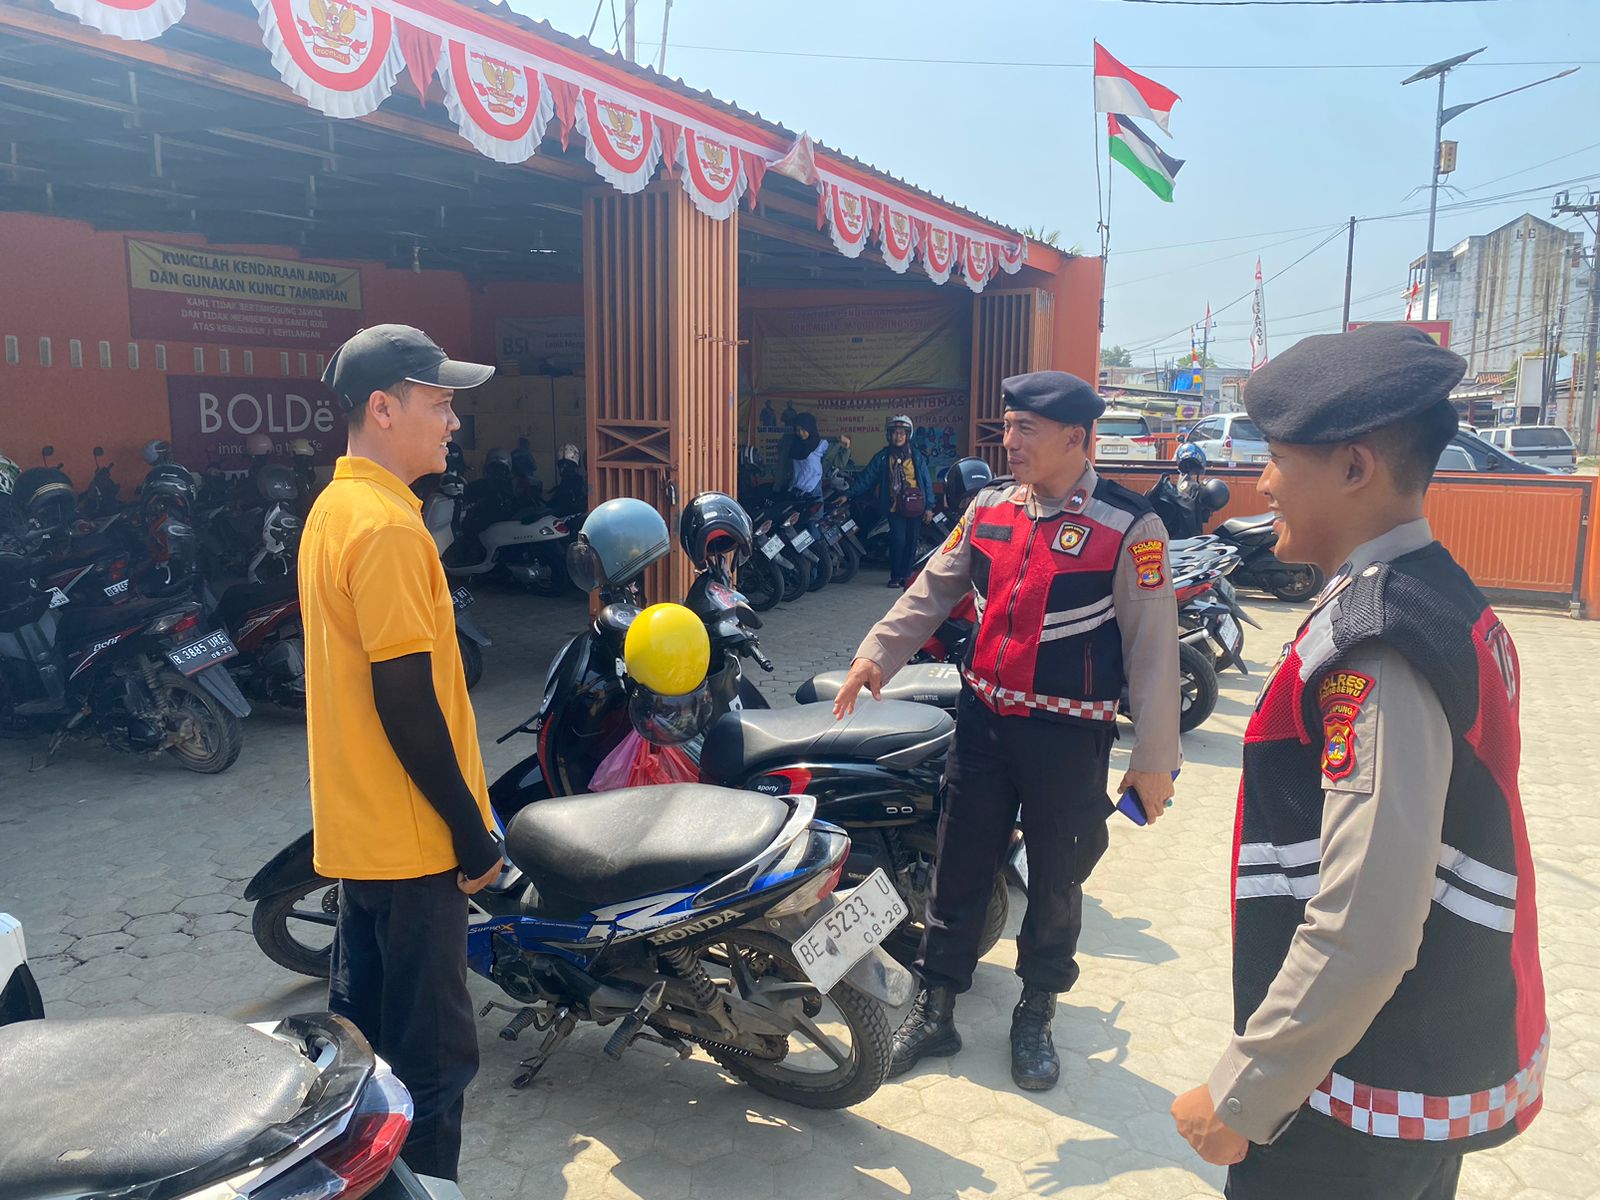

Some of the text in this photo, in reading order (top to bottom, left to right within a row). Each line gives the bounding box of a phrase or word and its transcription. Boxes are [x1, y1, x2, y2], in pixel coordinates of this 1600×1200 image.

[162, 252, 337, 285] KUNCILAH KENDARAAN ANDA
[150, 269, 348, 303] DAN GUNAKAN KUNCI TAMBAHAN
[181, 309, 201, 319] DAN
[202, 311, 228, 321] TIDAK
[192, 322, 215, 332] ATAS
[502, 337, 528, 355] BSI
[200, 392, 334, 434] BOLDë
[1320, 674, 1366, 690] OLRES
[757, 784, 778, 792] sporty
[646, 909, 746, 946] HONDA
[799, 875, 890, 966] BE 5233 U
